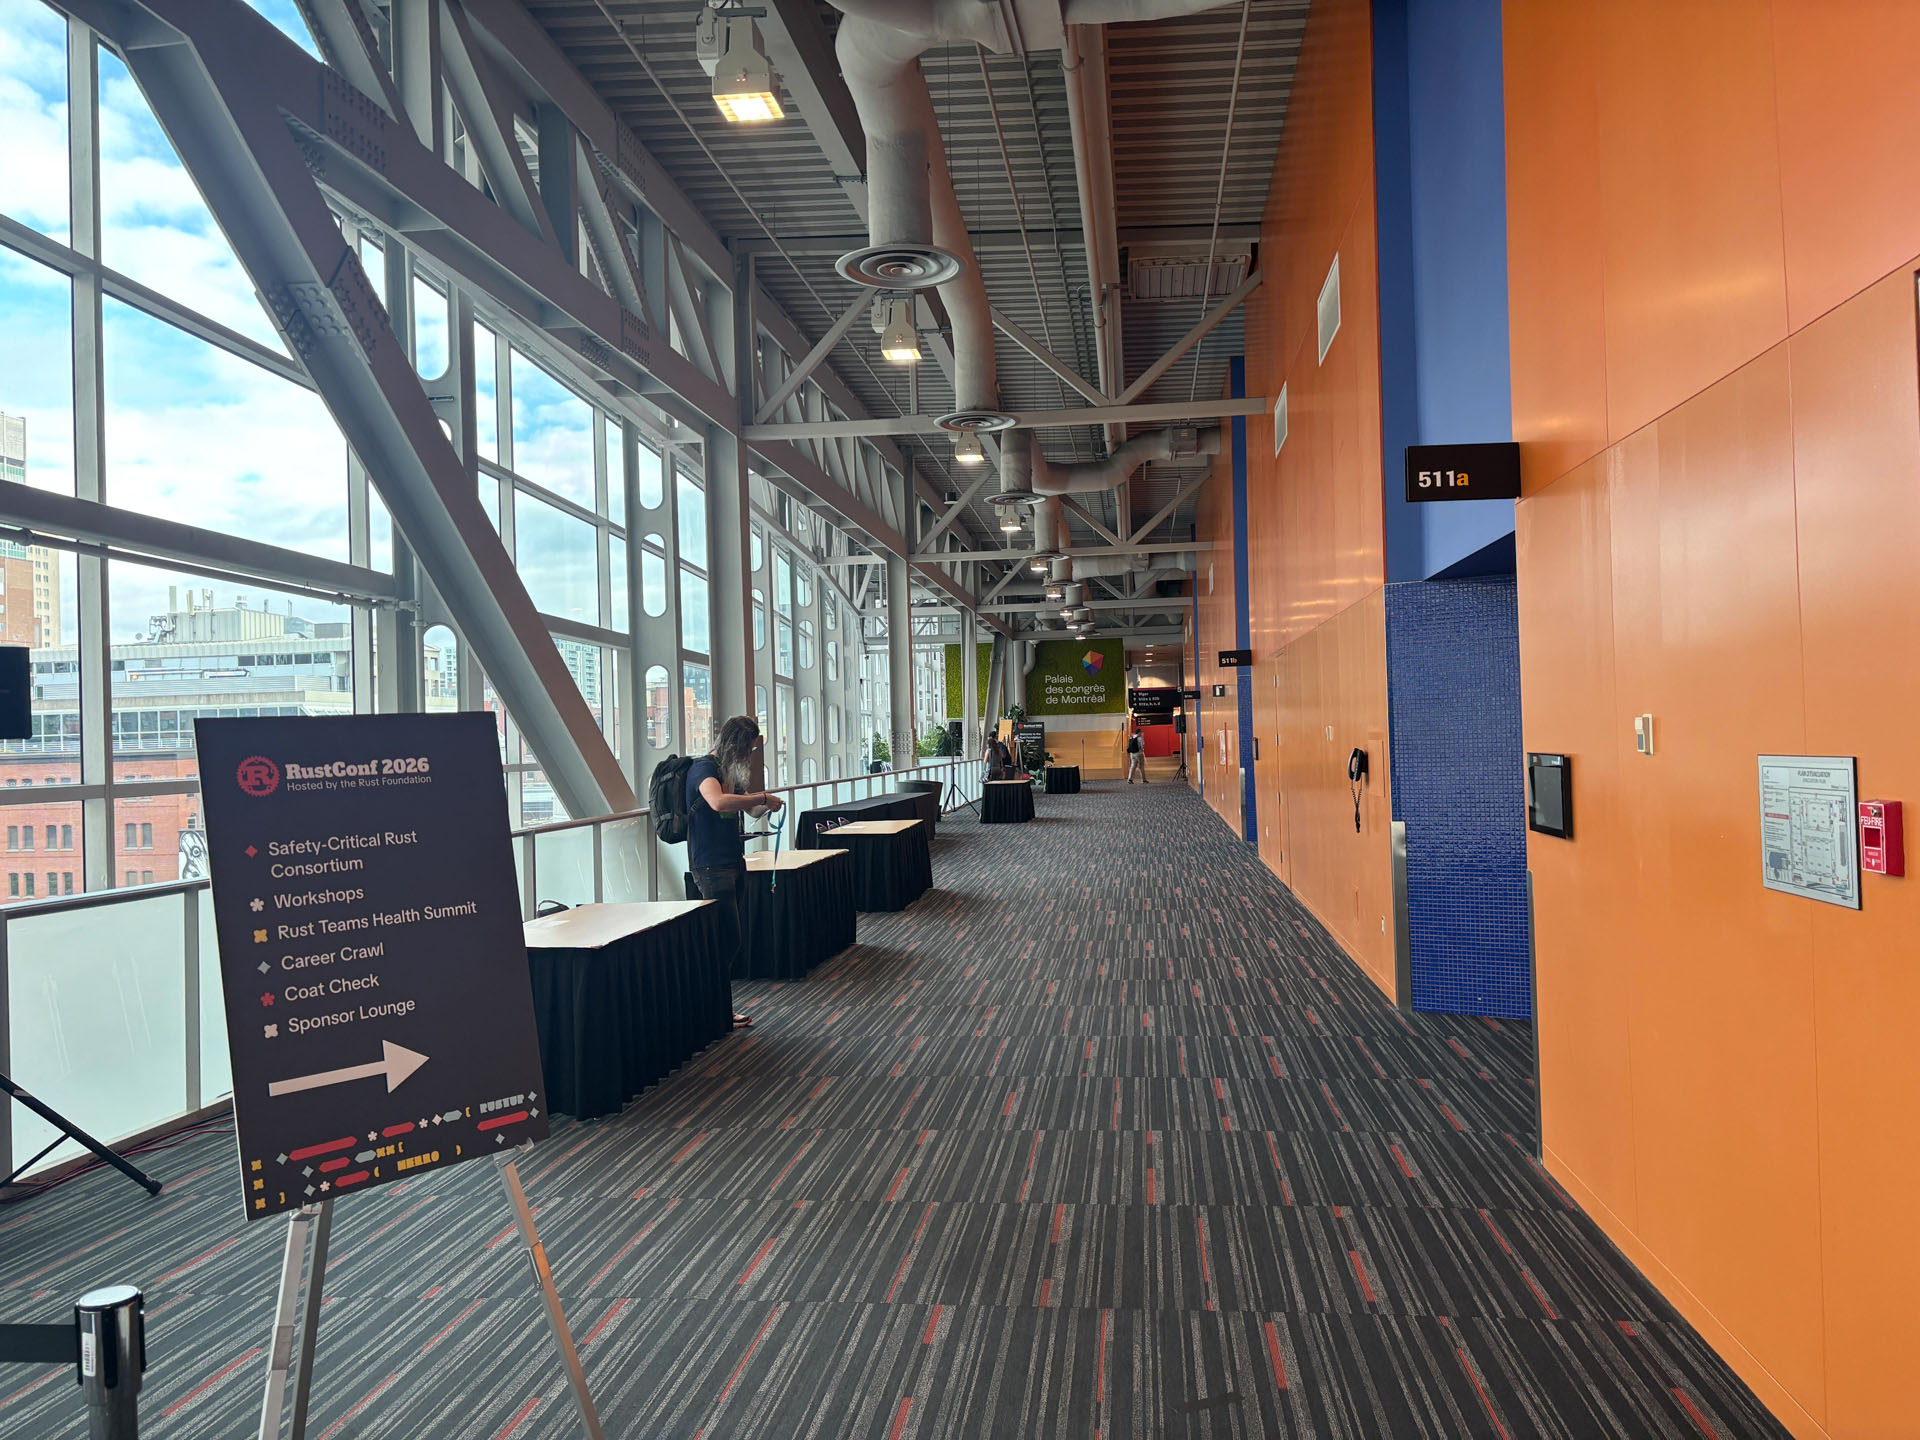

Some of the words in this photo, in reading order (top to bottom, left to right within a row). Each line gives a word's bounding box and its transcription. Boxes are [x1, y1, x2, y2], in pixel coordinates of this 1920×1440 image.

[1418, 470, 1469, 488] 511a
[1045, 674, 1073, 684] Palais
[1045, 685, 1064, 694] des
[1065, 684, 1105, 695] congrès
[1045, 696, 1059, 704] de
[1061, 694, 1106, 704] Montréal
[285, 760, 378, 780] RustConf
[382, 757, 430, 775] 2026
[287, 780, 323, 792] Hosted
[325, 779, 338, 791] by
[340, 778, 356, 788] the
[358, 776, 380, 787] Rust
[382, 774, 432, 786] Foundation
[268, 833, 381, 856] Safety-Critical
[384, 830, 418, 846] Rust
[271, 858, 364, 879] Consortium
[274, 888, 365, 909] Workshops
[277, 922, 316, 940] Rust
[318, 917, 369, 934] Teams
[372, 909, 421, 928] Health
[423, 901, 478, 920] Summit
[281, 952, 337, 970] Career
[340, 942, 385, 961] Crawl
[284, 983, 326, 1001] Coat
[329, 973, 380, 994] Check
[288, 1010, 356, 1035] Sponsor
[359, 1000, 416, 1020] Lounge
[479, 1094, 525, 1114] RUSTUP
